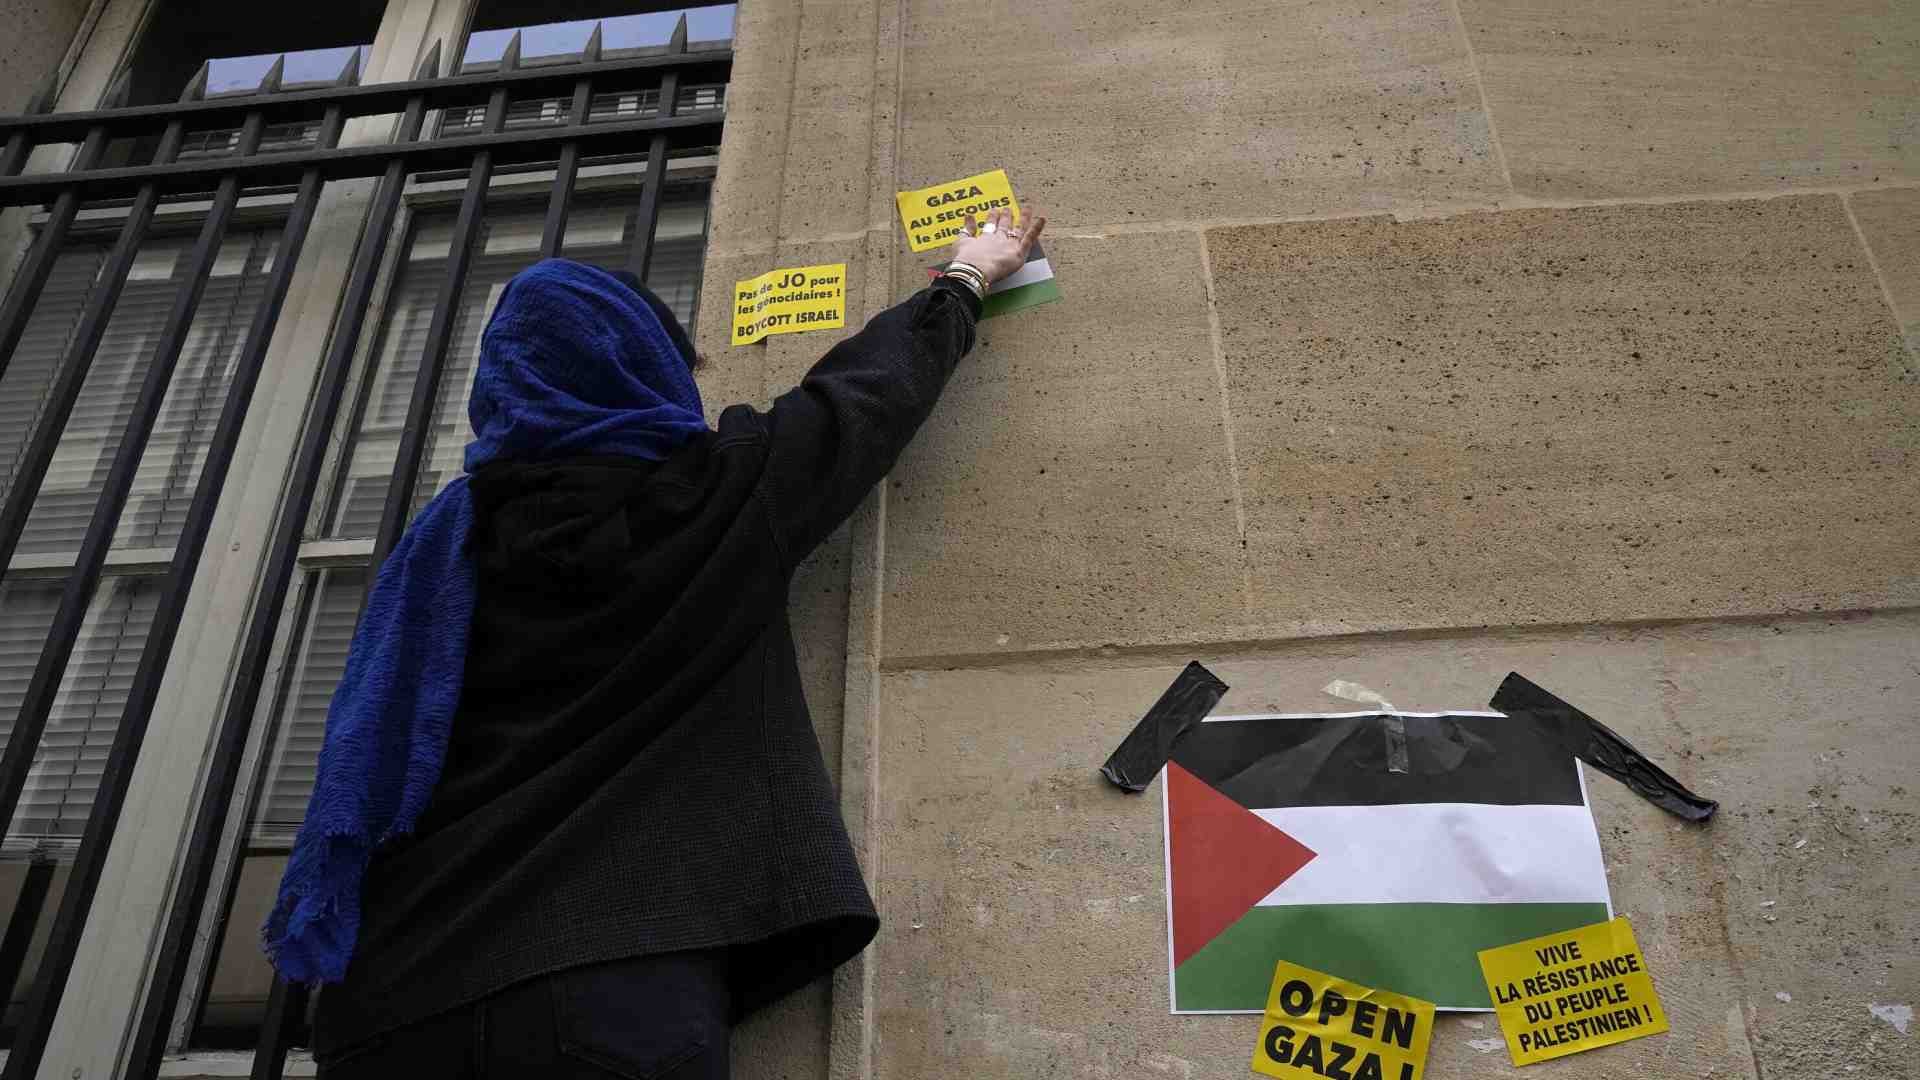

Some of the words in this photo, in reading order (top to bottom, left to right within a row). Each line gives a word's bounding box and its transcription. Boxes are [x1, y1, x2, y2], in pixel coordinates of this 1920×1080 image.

[926, 185, 983, 208] GAZA
[910, 216, 932, 230] AU
[936, 196, 1010, 223] SECOURS
[915, 234, 930, 244] le
[738, 304, 754, 314] les
[836, 288, 841, 297] !
[739, 290, 757, 300] Pas
[760, 283, 772, 293] de
[778, 273, 806, 288] JO
[810, 276, 840, 288] pour
[737, 314, 792, 336] BOYCOTT
[796, 309, 839, 323] ISRAEL
[1535, 941, 1582, 967] VIVE
[1495, 982, 1522, 1004] LA
[1523, 953, 1641, 998] RÉSISTANCE
[1280, 980, 1416, 1049] OPEN
[1524, 1001, 1553, 1024] DU
[1556, 982, 1629, 1016] PEUPLE
[1518, 1006, 1642, 1052] PALESTINIEN
[1642, 1004, 1653, 1023] !
[1265, 1025, 1383, 1080] GAZA
